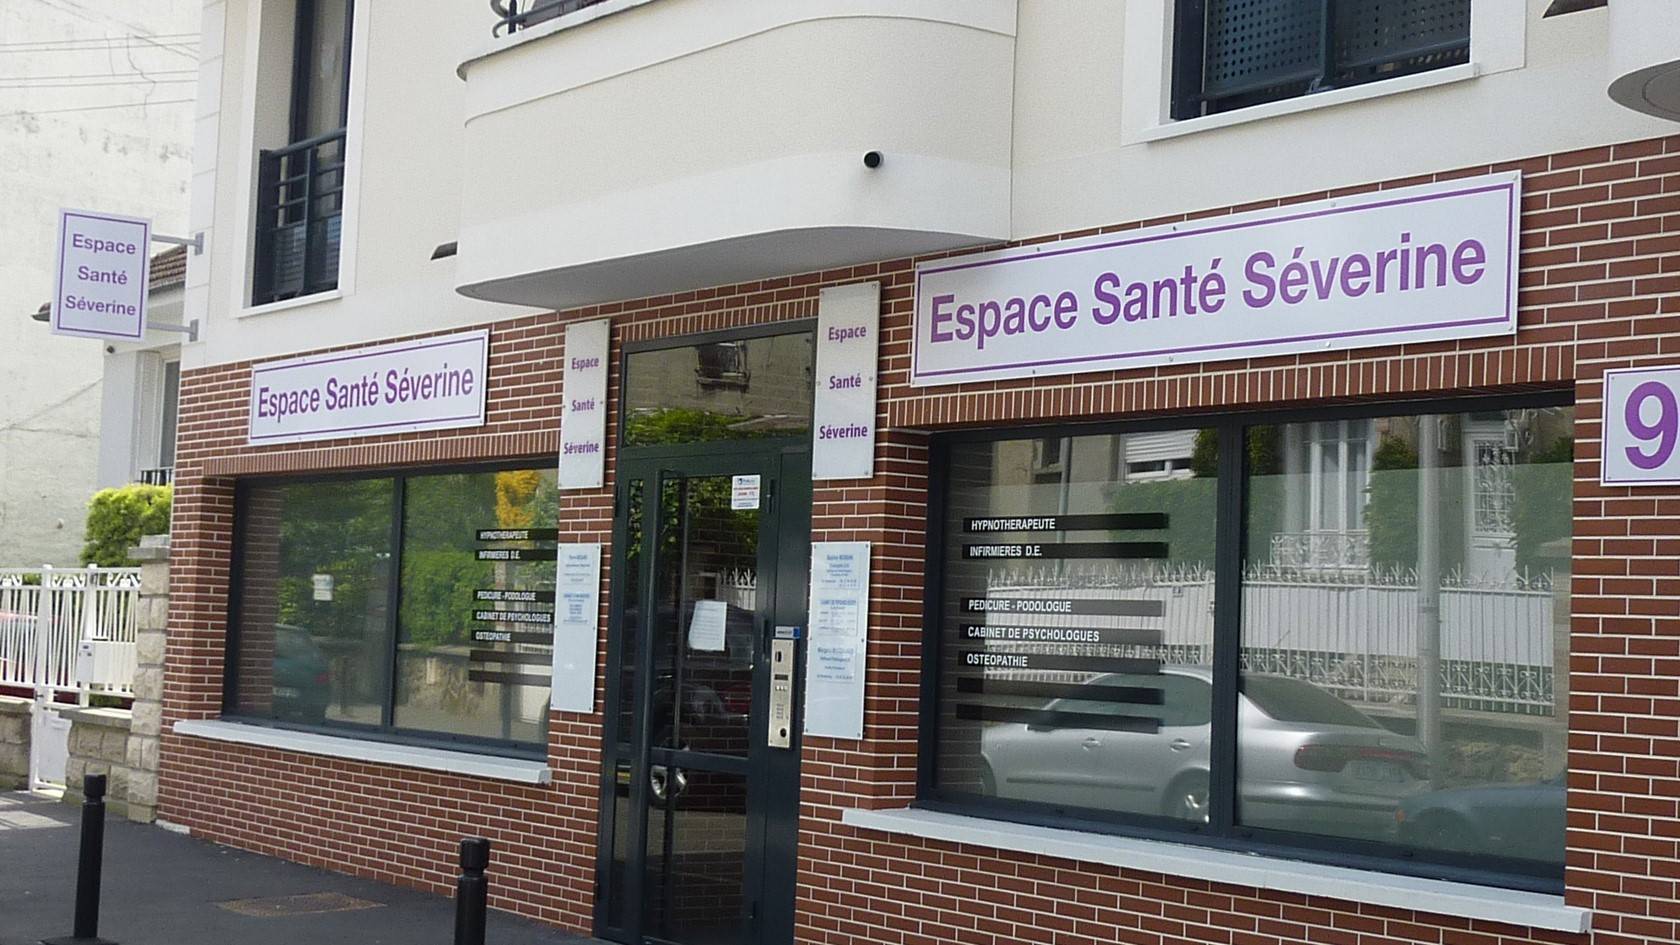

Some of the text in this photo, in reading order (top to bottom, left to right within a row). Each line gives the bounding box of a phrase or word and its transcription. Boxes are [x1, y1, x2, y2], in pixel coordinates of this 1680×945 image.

[72, 233, 137, 255] Espace
[78, 265, 128, 285] Santé
[930, 232, 1486, 350] Espace Santé Séverine
[65, 295, 137, 316] Séverine
[828, 325, 867, 343] Espace
[571, 356, 600, 372] Espace
[829, 372, 862, 390] Santé
[258, 362, 474, 423] Espace Santé Séverine
[571, 399, 595, 412] Santé
[819, 423, 868, 440] Séverine
[1624, 381, 1679, 470] 9
[563, 441, 600, 455] Séverine
[971, 518, 1056, 531] HYPNOTHERAPEUTE
[970, 545, 1043, 557] INFIRMIERES D.E.
[968, 626, 1100, 642] CABINET DE PSYCHOLOGUES
[966, 653, 1028, 667] OSTEOPATHIE
